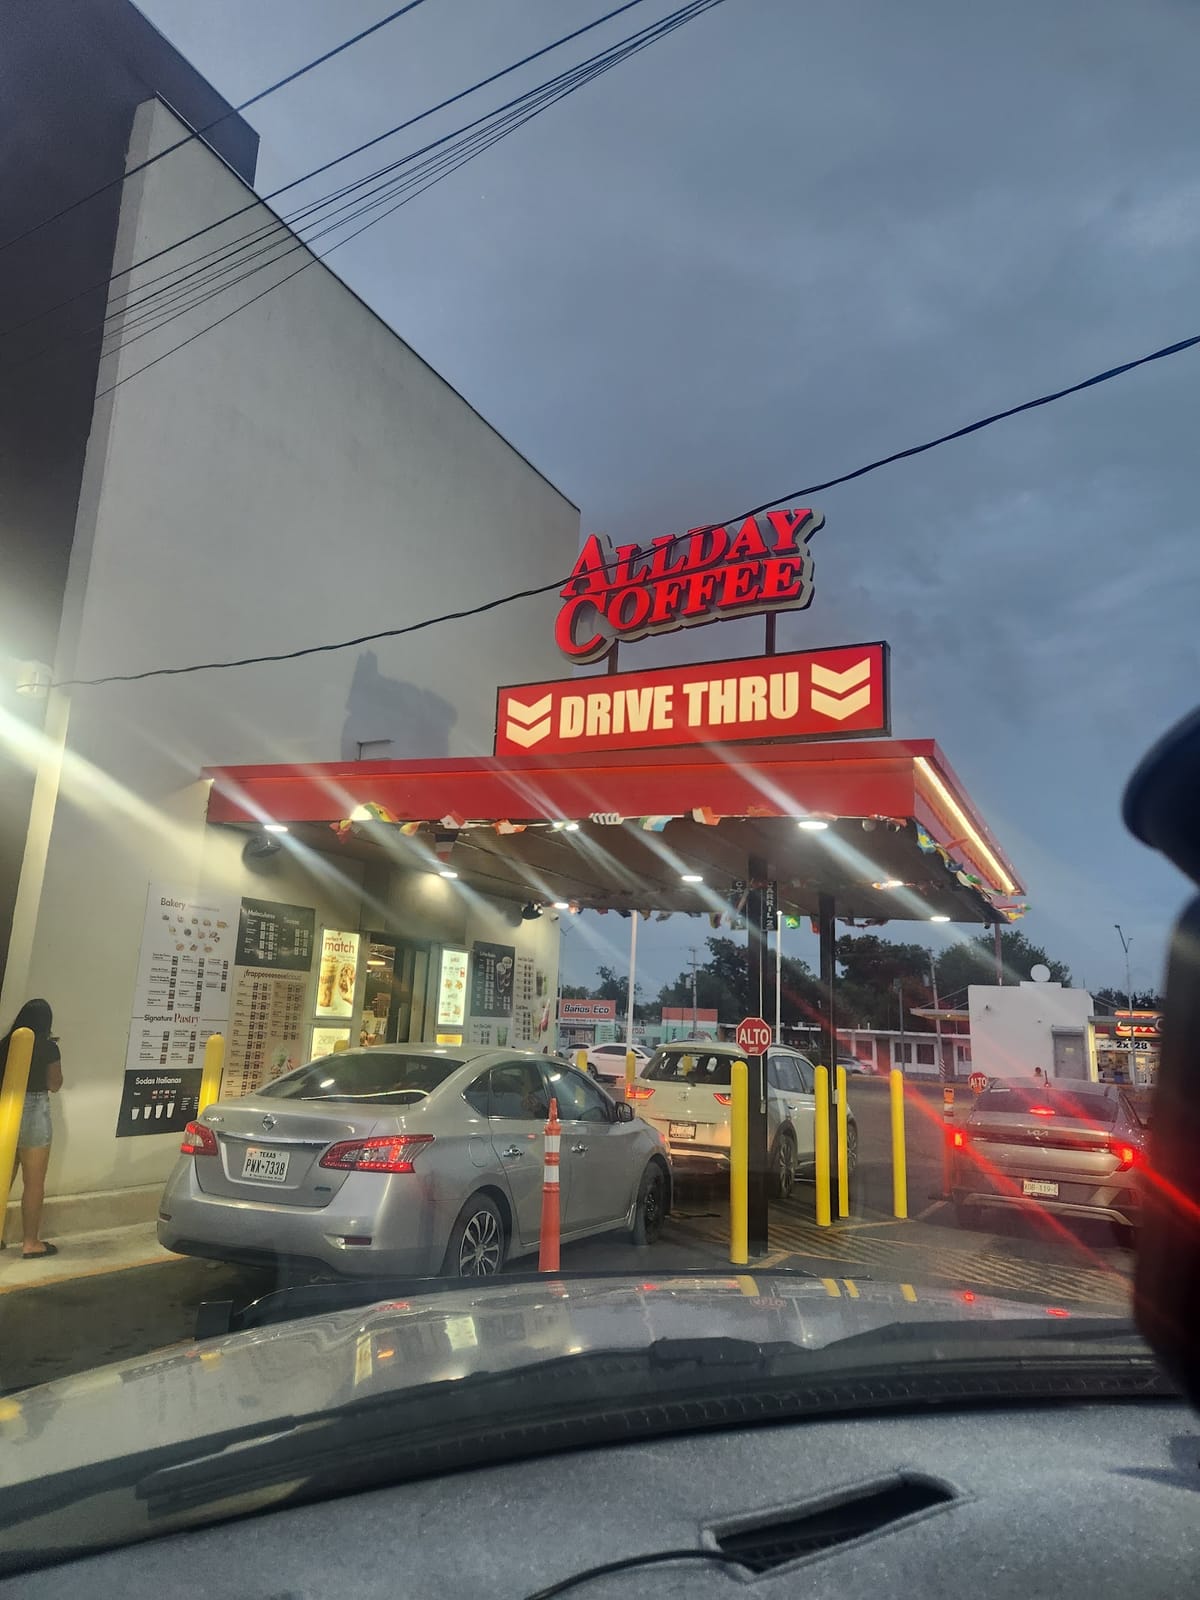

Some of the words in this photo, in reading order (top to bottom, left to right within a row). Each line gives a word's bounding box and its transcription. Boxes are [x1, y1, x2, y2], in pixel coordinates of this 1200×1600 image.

[560, 508, 812, 597] ALLDAY
[555, 556, 804, 656] COFFEE
[558, 684, 674, 739] DRIVE
[682, 671, 800, 728] THRU
[160, 897, 186, 911] Bakery
[325, 940, 355, 954] match
[563, 1003, 590, 1014] Baños
[593, 1005, 610, 1014] Eco
[143, 1014, 173, 1023] Signature
[174, 1013, 200, 1024] Pastry
[739, 1028, 769, 1045] ALTO
[135, 1077, 155, 1085] Sodas
[155, 1076, 182, 1084] Italianas
[970, 1077, 987, 1089] ALTO
[260, 1151, 276, 1159] TEXAS
